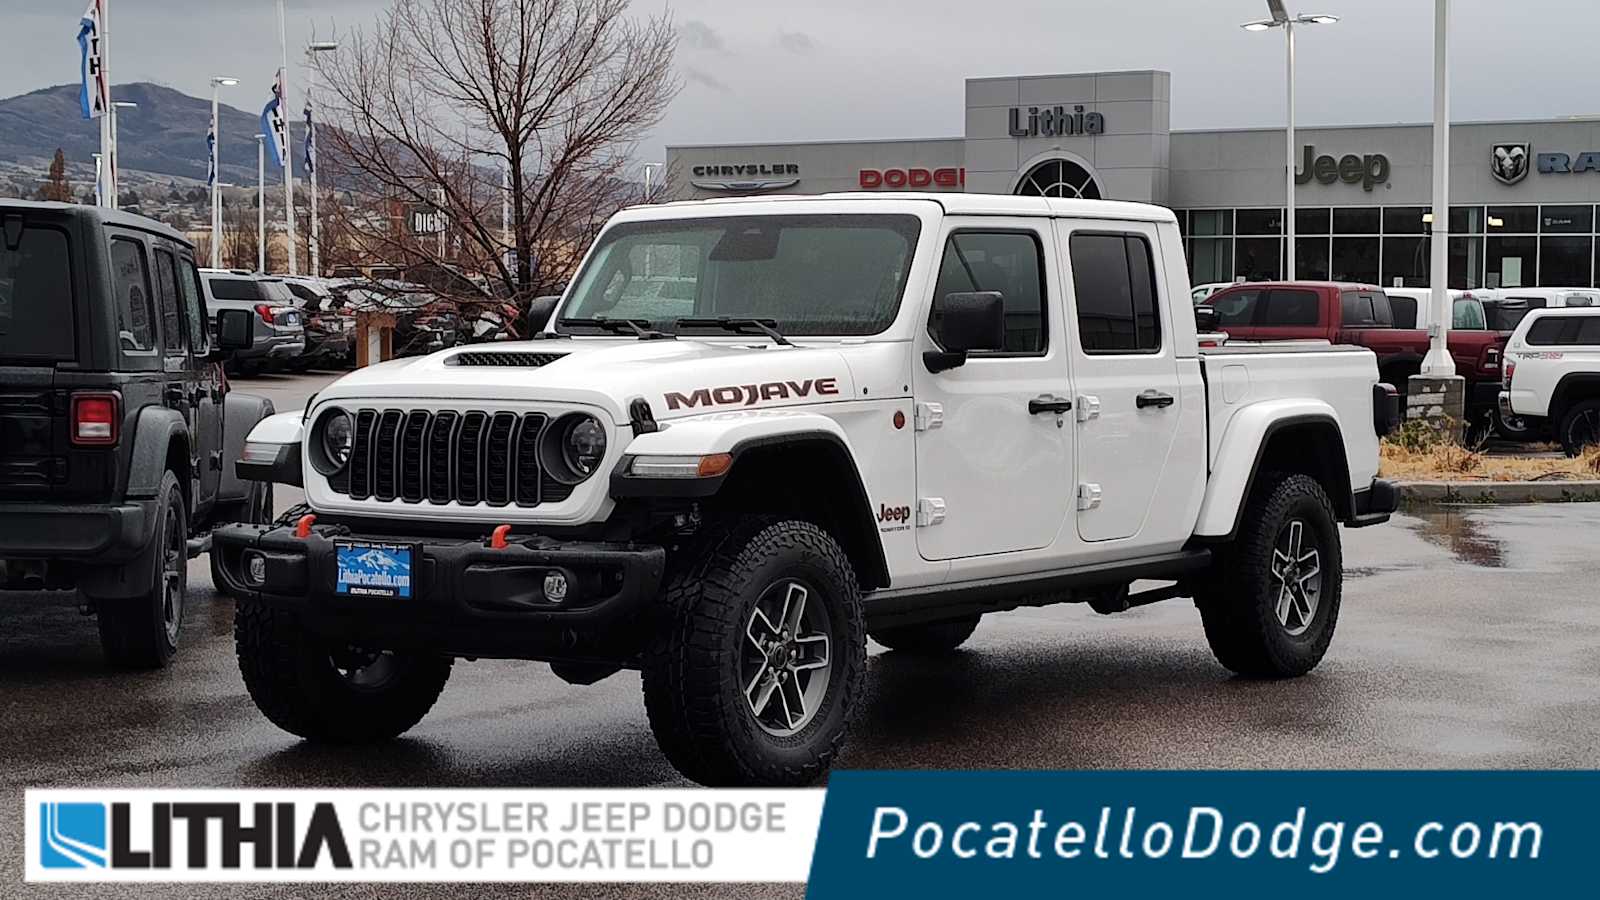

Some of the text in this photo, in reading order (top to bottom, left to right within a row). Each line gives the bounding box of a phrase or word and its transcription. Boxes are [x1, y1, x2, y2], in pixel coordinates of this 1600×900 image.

[1009, 105, 1104, 137] Lithia
[693, 164, 799, 177] CHRYSLER
[1286, 145, 1391, 192] Jeep
[1537, 152, 1600, 173] RA
[860, 168, 965, 188] DODG
[664, 378, 839, 410] MOJAVE
[876, 503, 910, 524] Jeep
